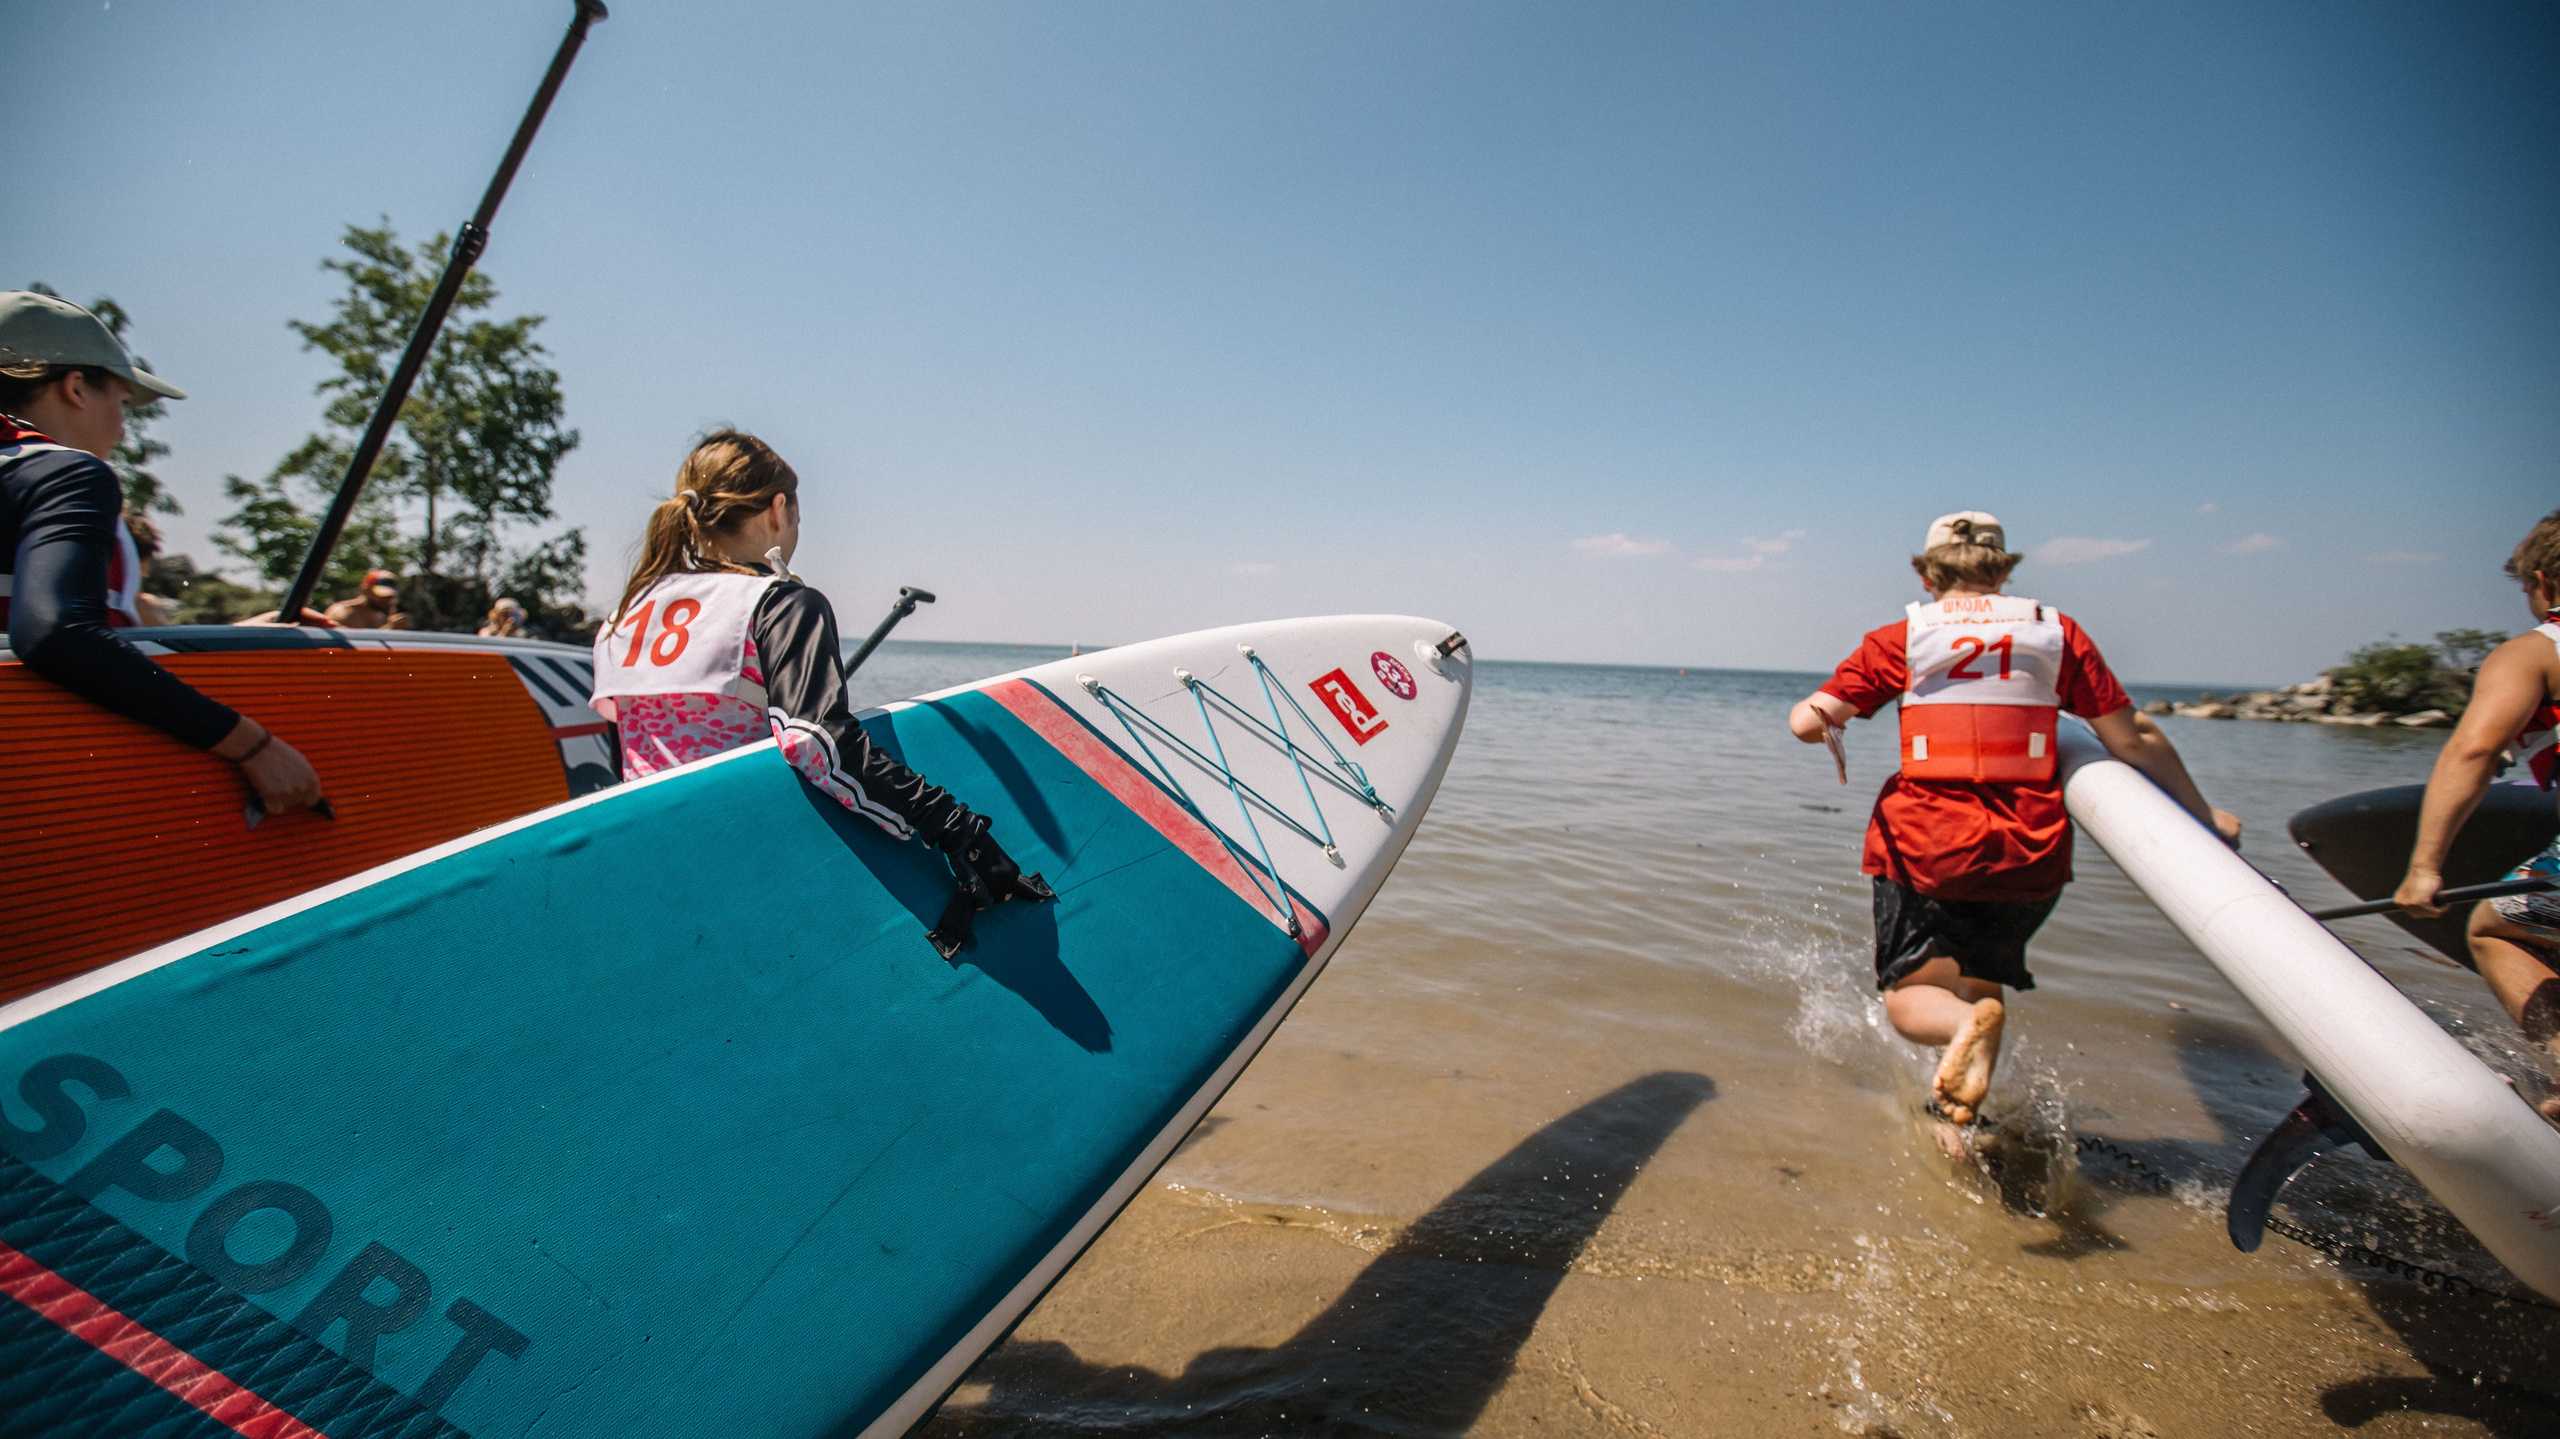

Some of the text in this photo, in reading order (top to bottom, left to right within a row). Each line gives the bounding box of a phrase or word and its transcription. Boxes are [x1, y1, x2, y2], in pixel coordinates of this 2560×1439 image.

[621, 597, 702, 668] 18
[1943, 598, 1993, 613] ШКОЛА
[1947, 634, 2013, 680] 21
[1323, 679, 1383, 734] red
[0, 1053, 532, 1420] SPORT
